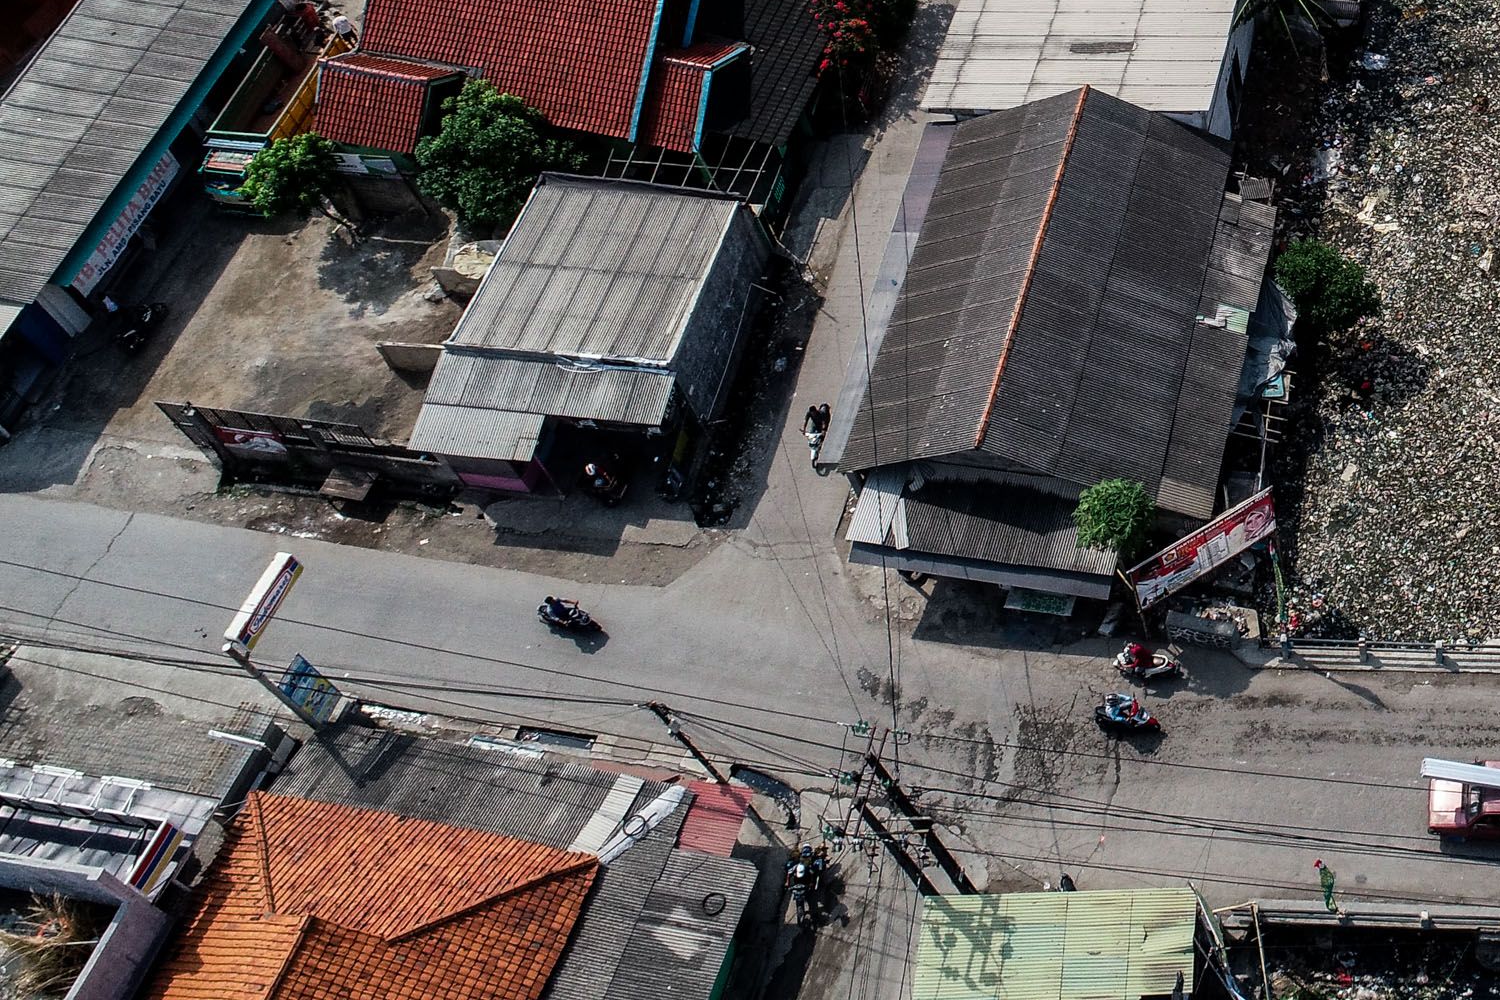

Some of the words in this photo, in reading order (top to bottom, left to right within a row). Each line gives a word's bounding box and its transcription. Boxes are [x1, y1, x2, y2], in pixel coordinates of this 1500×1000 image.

[96, 201, 140, 258] PELITA
[138, 153, 171, 200] BARU
[98, 258, 114, 276] JLN.
[127, 202, 151, 233] PISANG
[149, 180, 167, 202] BATU
